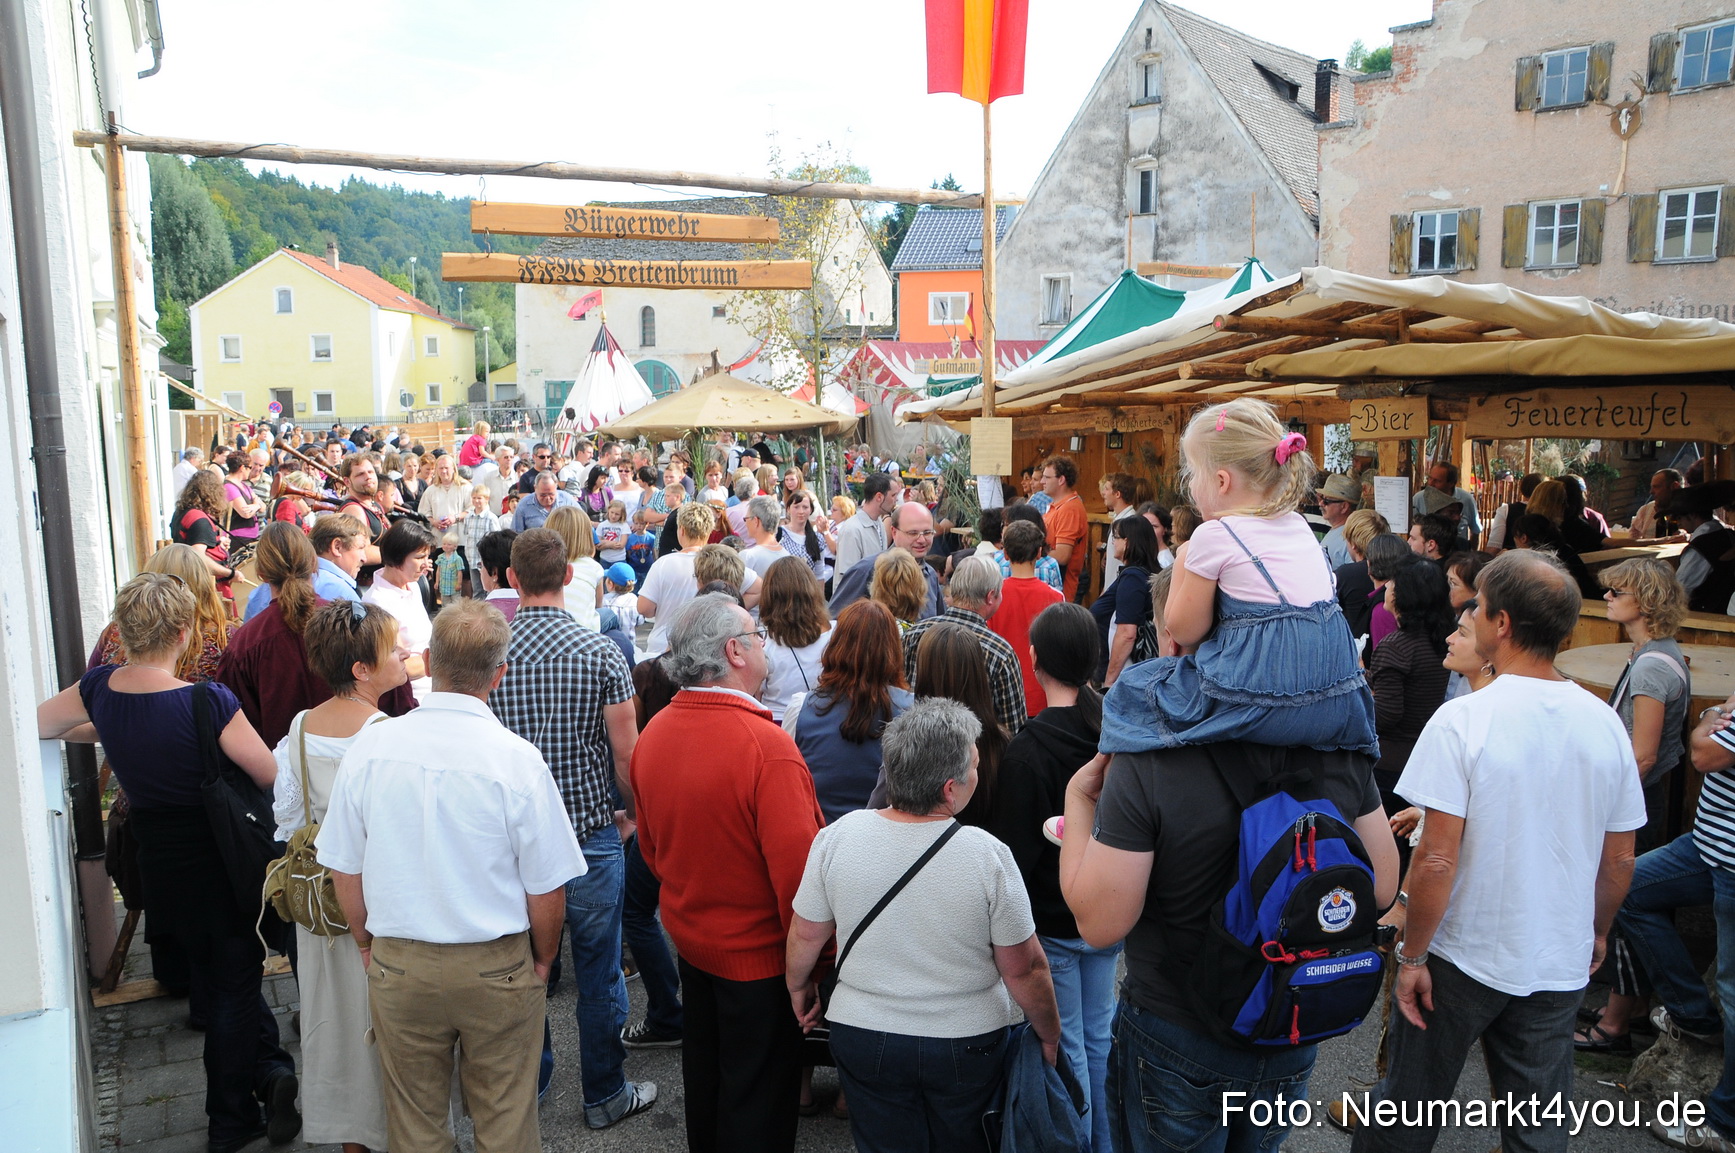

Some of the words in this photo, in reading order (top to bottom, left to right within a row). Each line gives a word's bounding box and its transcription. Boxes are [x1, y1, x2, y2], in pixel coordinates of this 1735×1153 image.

[563, 206, 700, 239] Bürgerwehr
[517, 254, 586, 285] FFW
[592, 258, 740, 287] Breitenbrunn
[933, 360, 976, 374] Gutmann
[1360, 403, 1414, 432] Bier
[1505, 391, 1691, 435] Feuerteufel
[1306, 962, 1346, 976] SCHNEIDER
[1346, 957, 1373, 970] WEISSE
